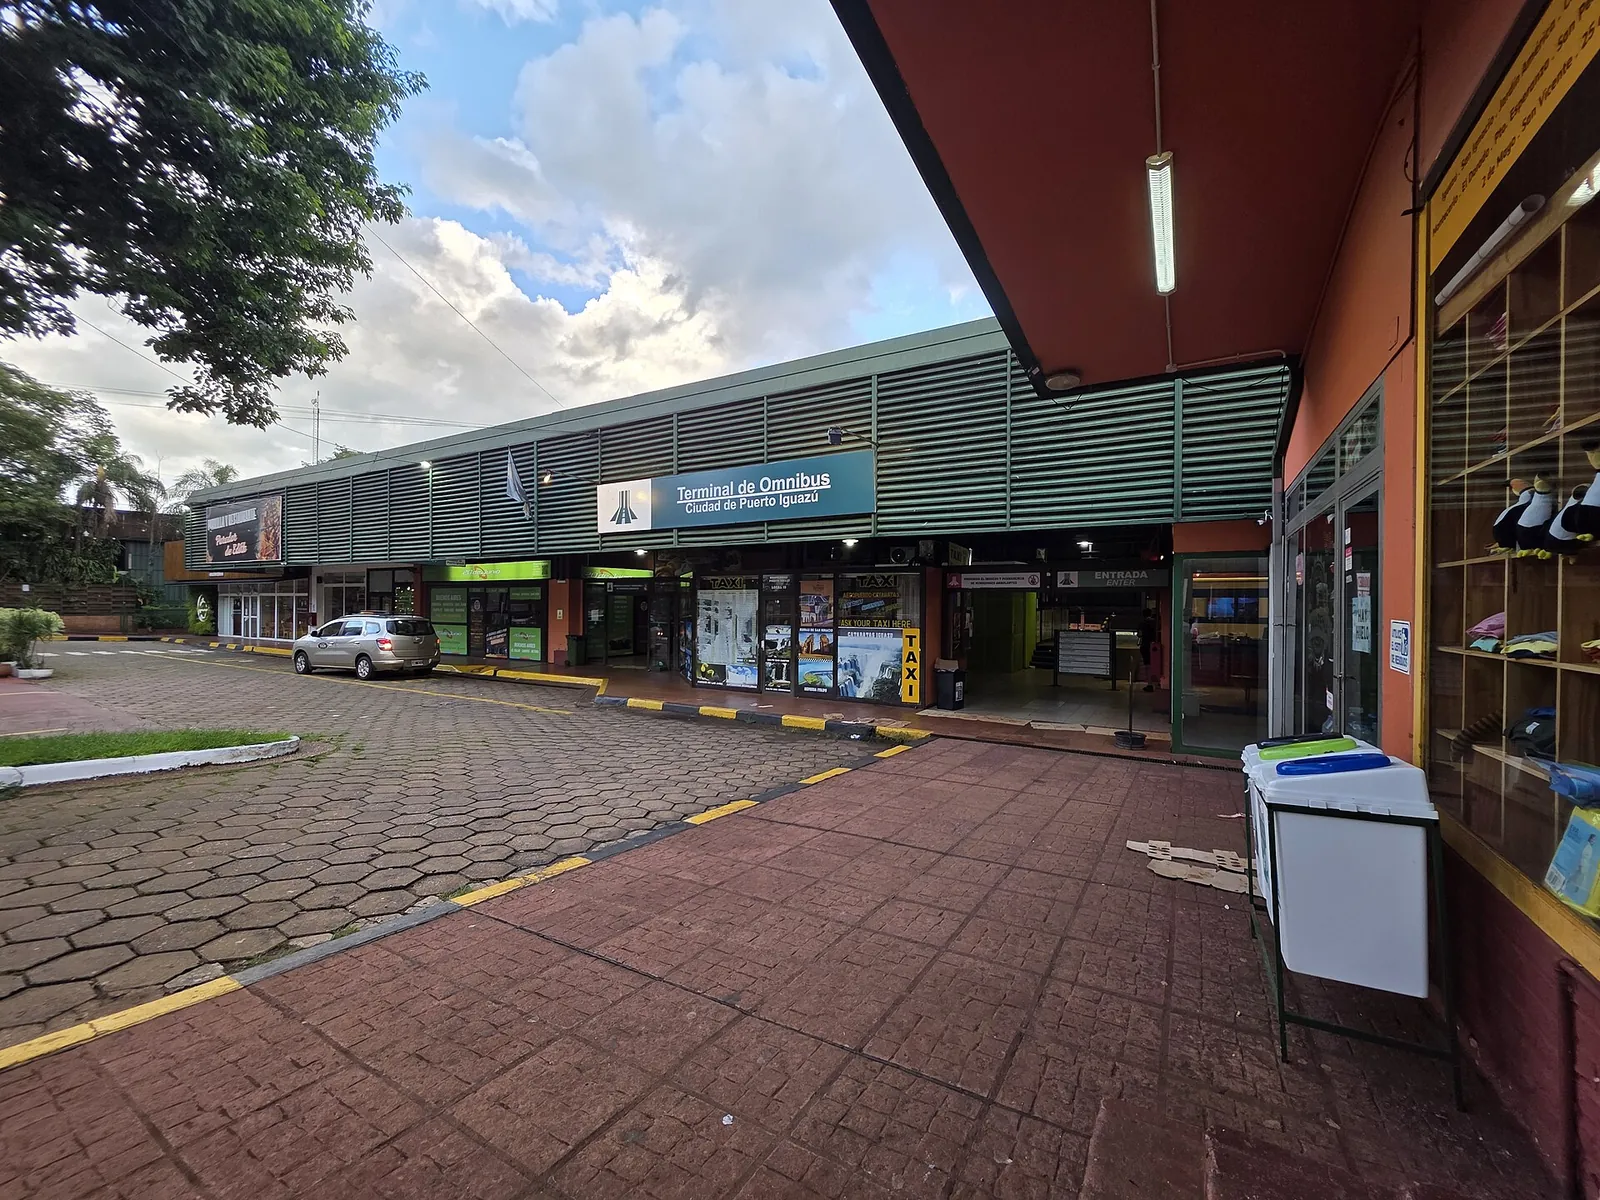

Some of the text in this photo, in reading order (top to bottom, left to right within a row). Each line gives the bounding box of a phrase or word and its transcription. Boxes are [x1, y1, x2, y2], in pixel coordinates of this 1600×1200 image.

[1510, 57, 1550, 121] Esperanza
[1556, 19, 1576, 52] San
[1522, 106, 1537, 132] San
[1538, 56, 1573, 107] Vicente
[1581, 20, 1595, 50] 25
[676, 472, 831, 501] Terminal de Omnibus
[685, 489, 819, 514] Ciudad de Puerto Iguazú
[709, 576, 745, 589] TAXI
[856, 574, 898, 588] TAXI
[1094, 570, 1148, 580] ENTRADA
[1106, 578, 1136, 587] ENTER
[840, 619, 911, 629] ASK YOUR TAXI HERE
[905, 634, 917, 697] TAXI
